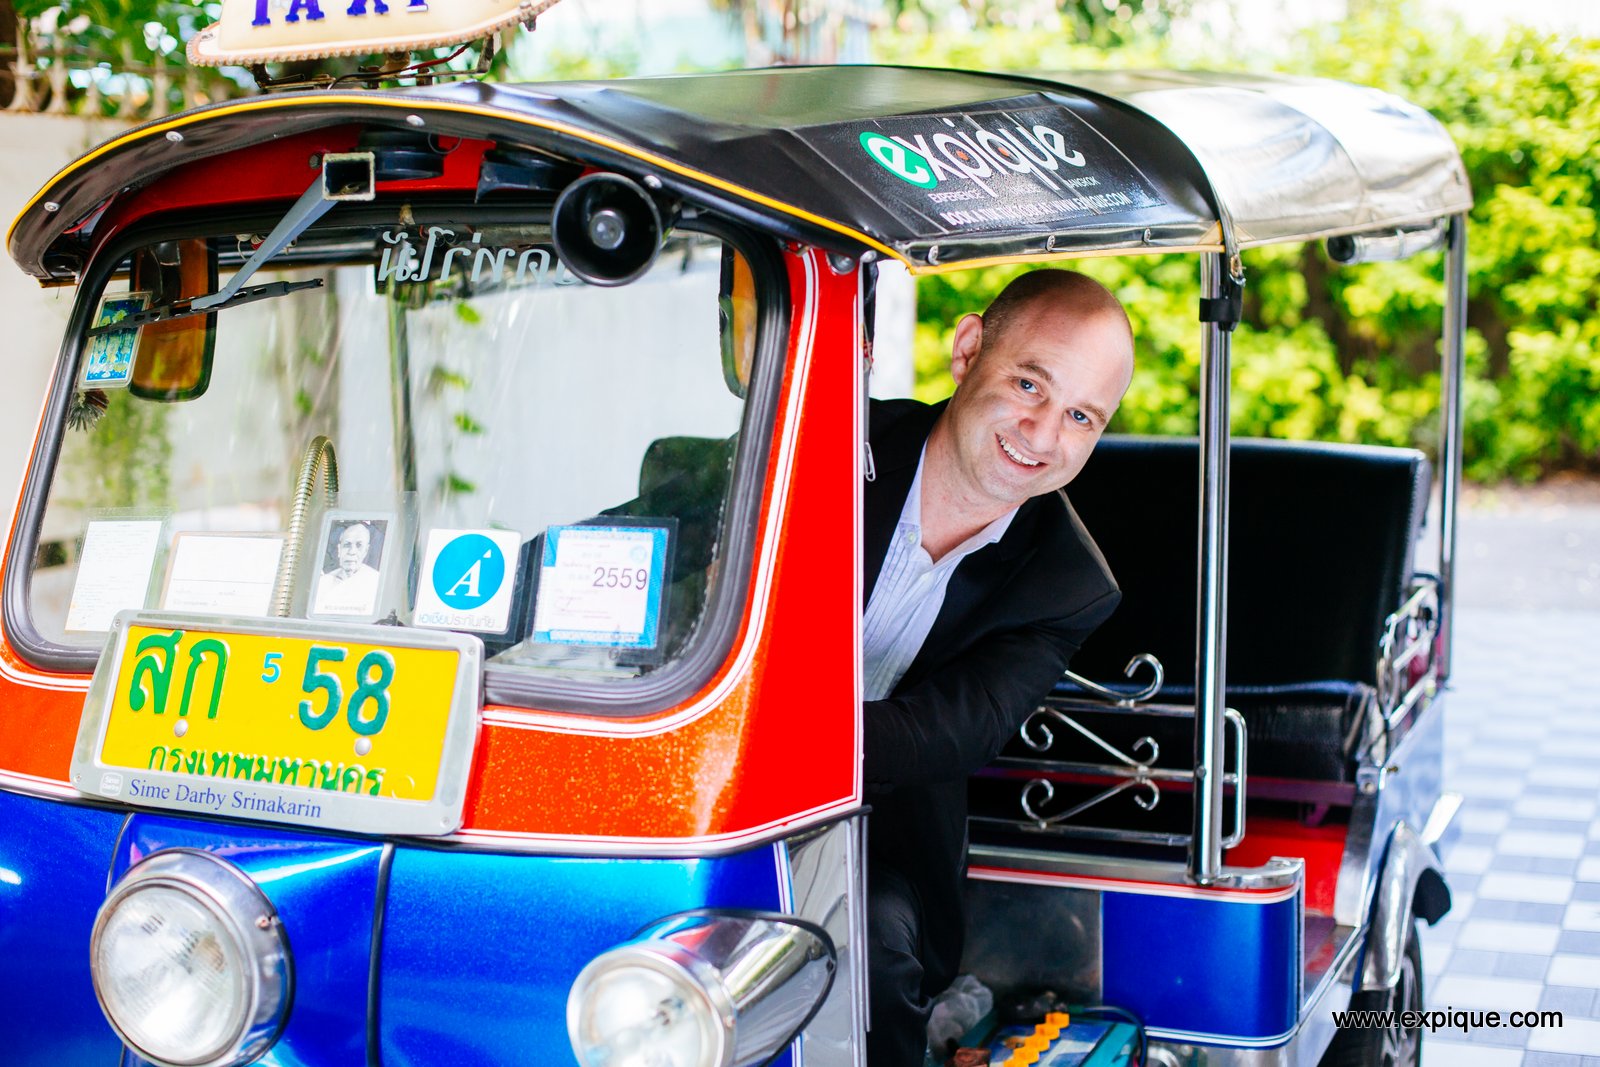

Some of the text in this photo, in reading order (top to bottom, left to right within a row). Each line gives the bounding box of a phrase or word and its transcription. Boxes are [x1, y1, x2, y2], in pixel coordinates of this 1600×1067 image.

[862, 117, 1086, 198] expique
[592, 566, 648, 591] 2559
[261, 653, 284, 684] 5
[299, 644, 396, 737] 58
[148, 745, 386, 797] กรงเทพมหานคร
[129, 778, 323, 819] Sime Darby Srinakarin
